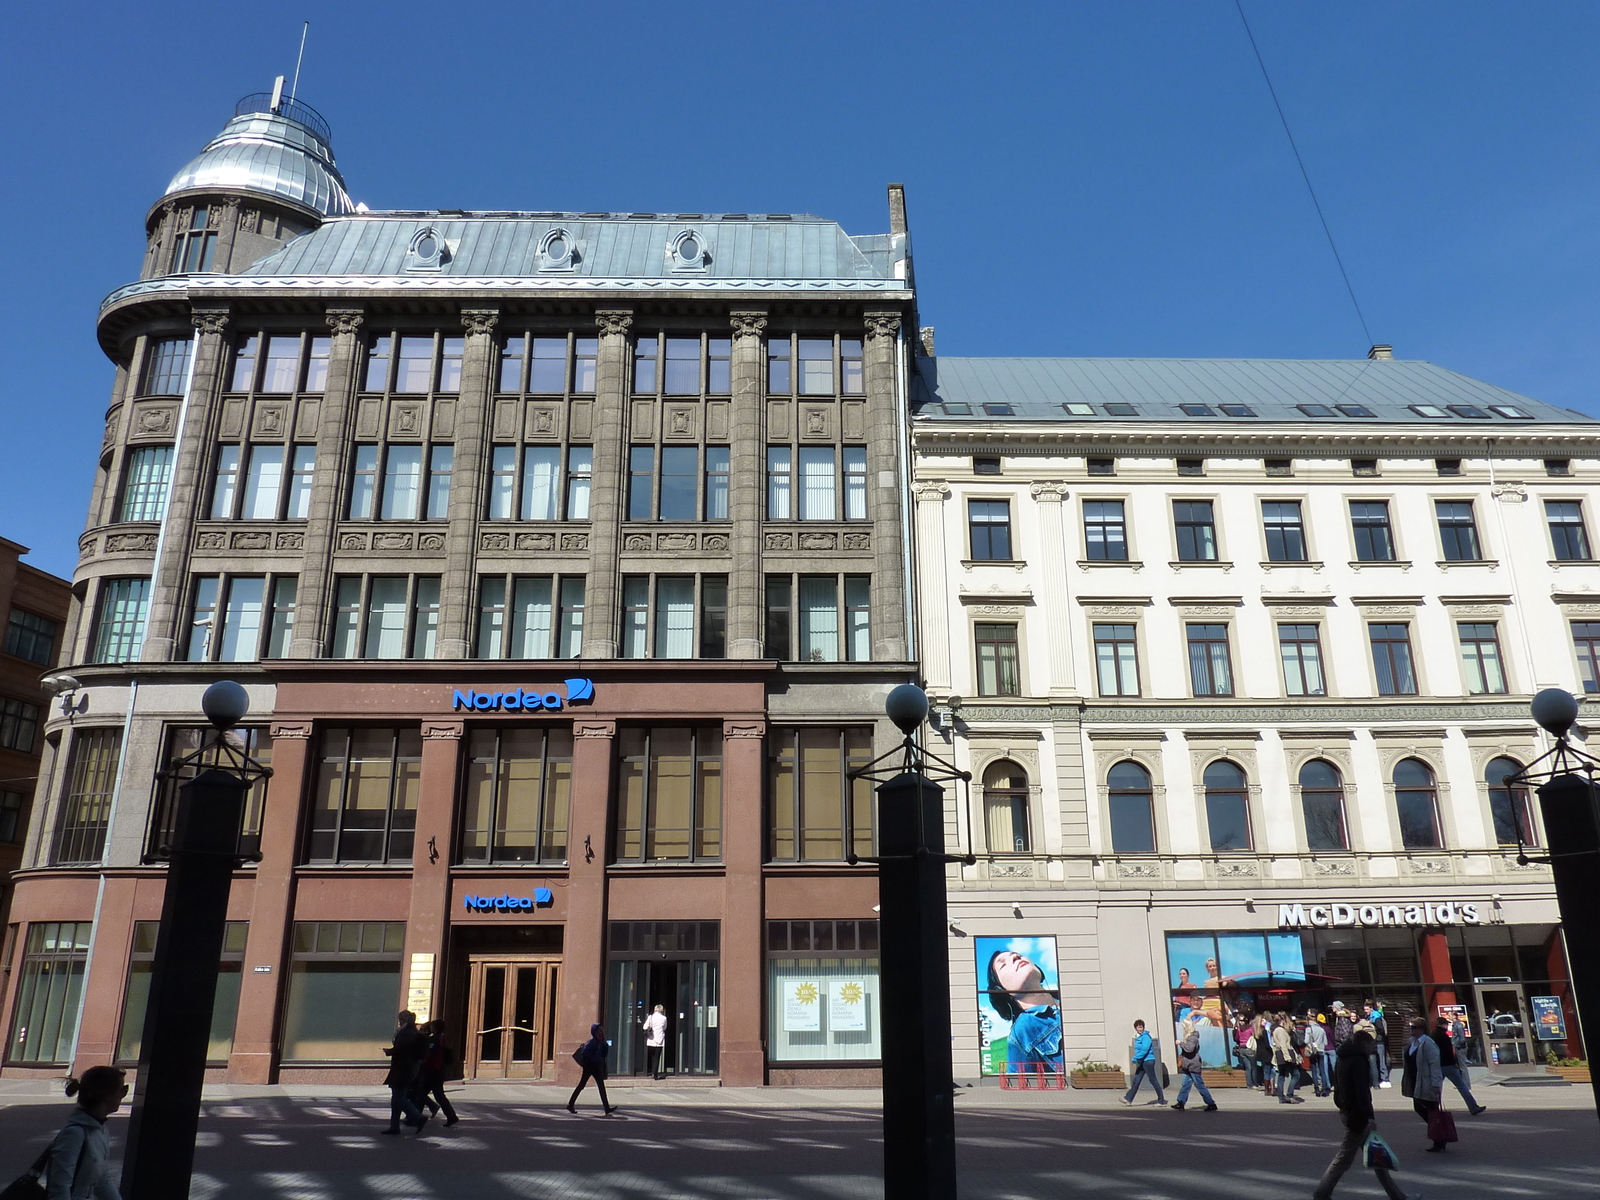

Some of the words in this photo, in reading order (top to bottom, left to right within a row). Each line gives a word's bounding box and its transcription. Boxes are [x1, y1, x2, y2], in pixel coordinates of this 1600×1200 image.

[452, 688, 562, 709] Nordea
[463, 894, 533, 909] Nordea
[1279, 902, 1479, 926] McDonald's
[981, 1053, 992, 1073] i'm
